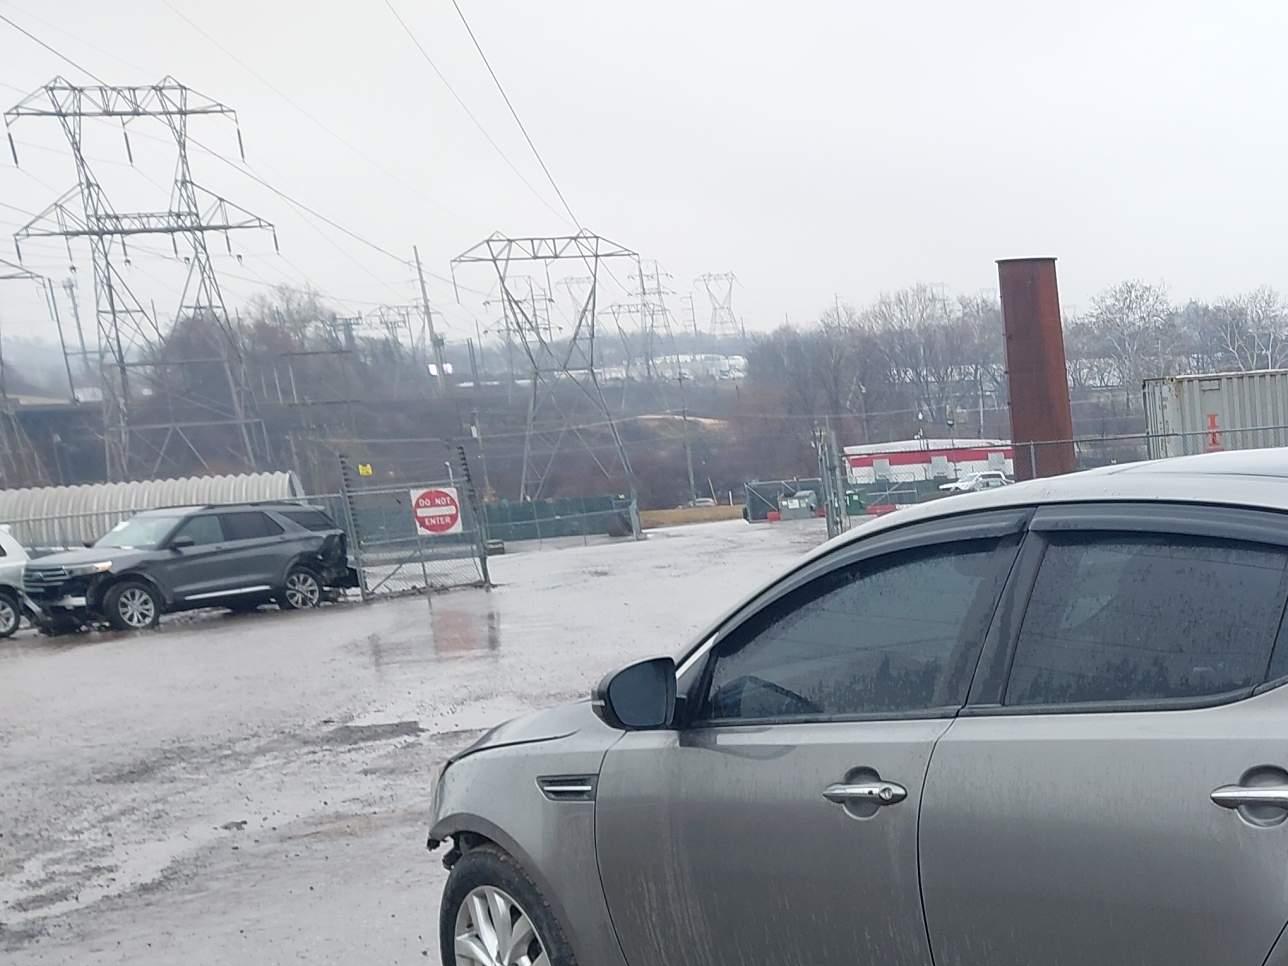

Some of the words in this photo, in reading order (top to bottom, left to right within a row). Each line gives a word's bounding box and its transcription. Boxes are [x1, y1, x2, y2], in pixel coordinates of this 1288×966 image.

[418, 498, 431, 507] DO
[434, 496, 451, 505] NOT
[424, 516, 452, 526] ENTER
